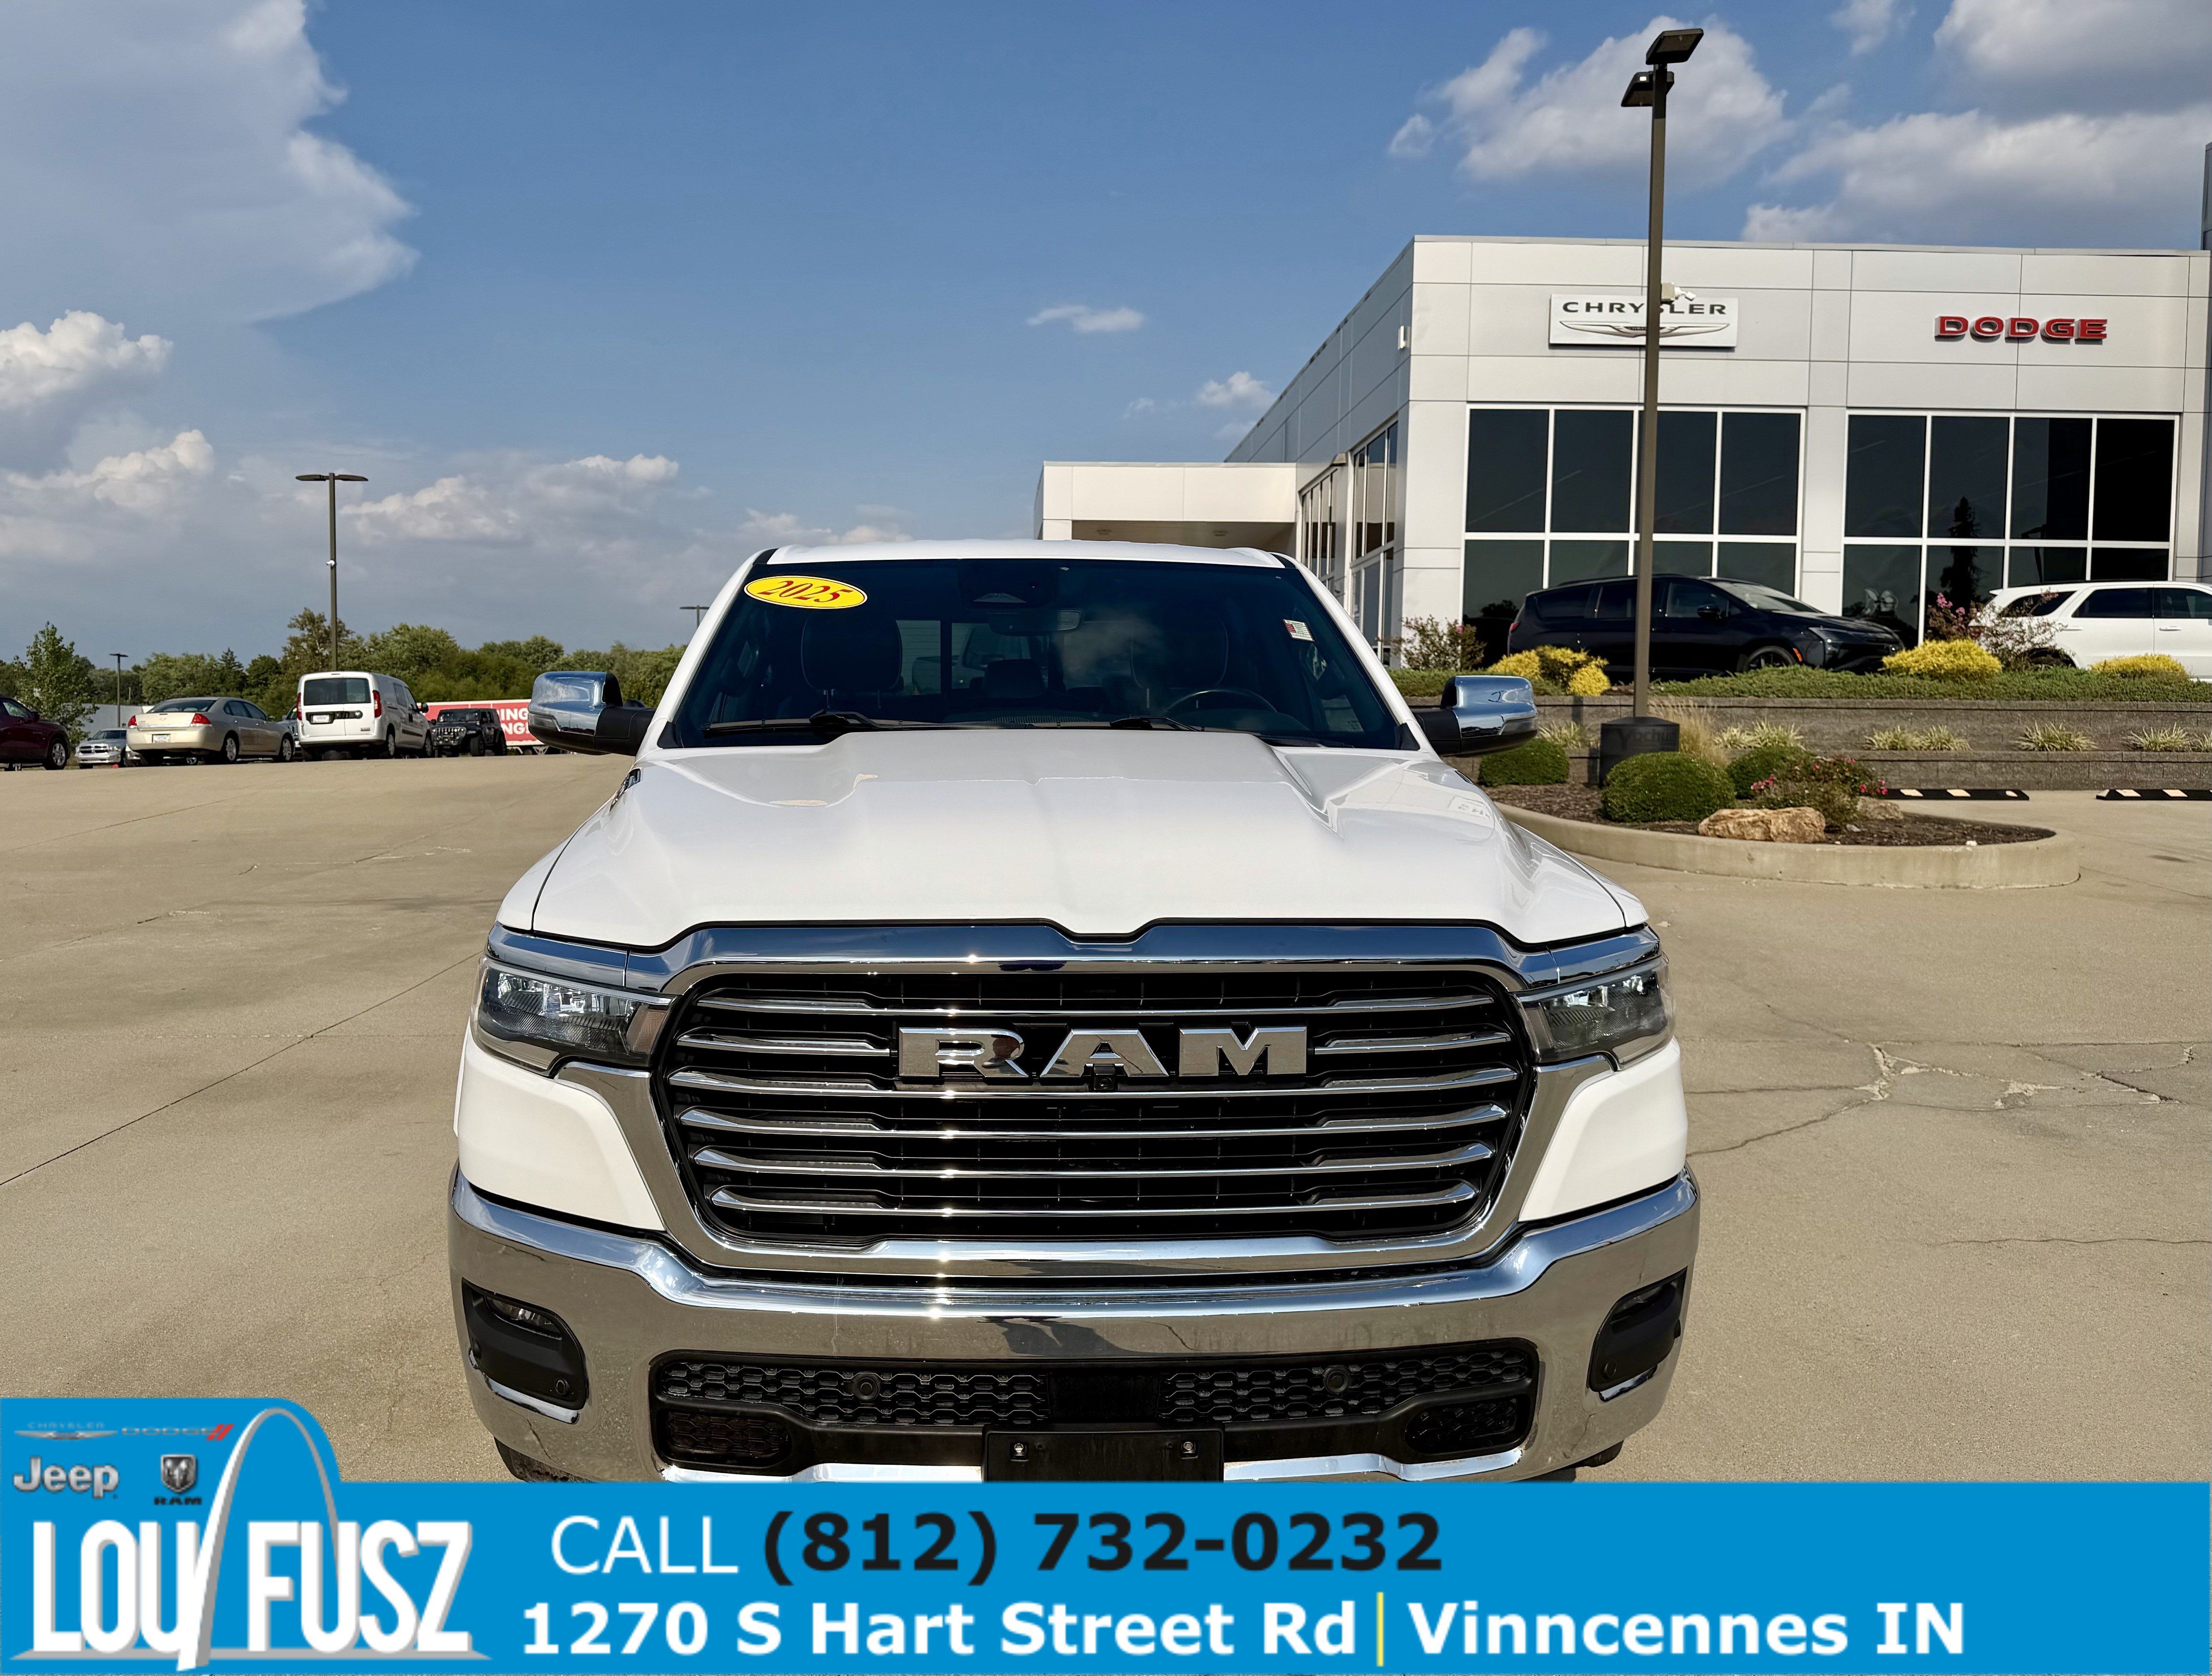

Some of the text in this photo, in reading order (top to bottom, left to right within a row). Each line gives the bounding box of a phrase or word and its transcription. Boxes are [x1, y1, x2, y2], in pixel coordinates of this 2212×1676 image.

[1563, 301, 1726, 315] CHRYLER
[1936, 316, 2107, 340] DODGE
[757, 580, 854, 602] 2025
[898, 1026, 1307, 1078] RAM
